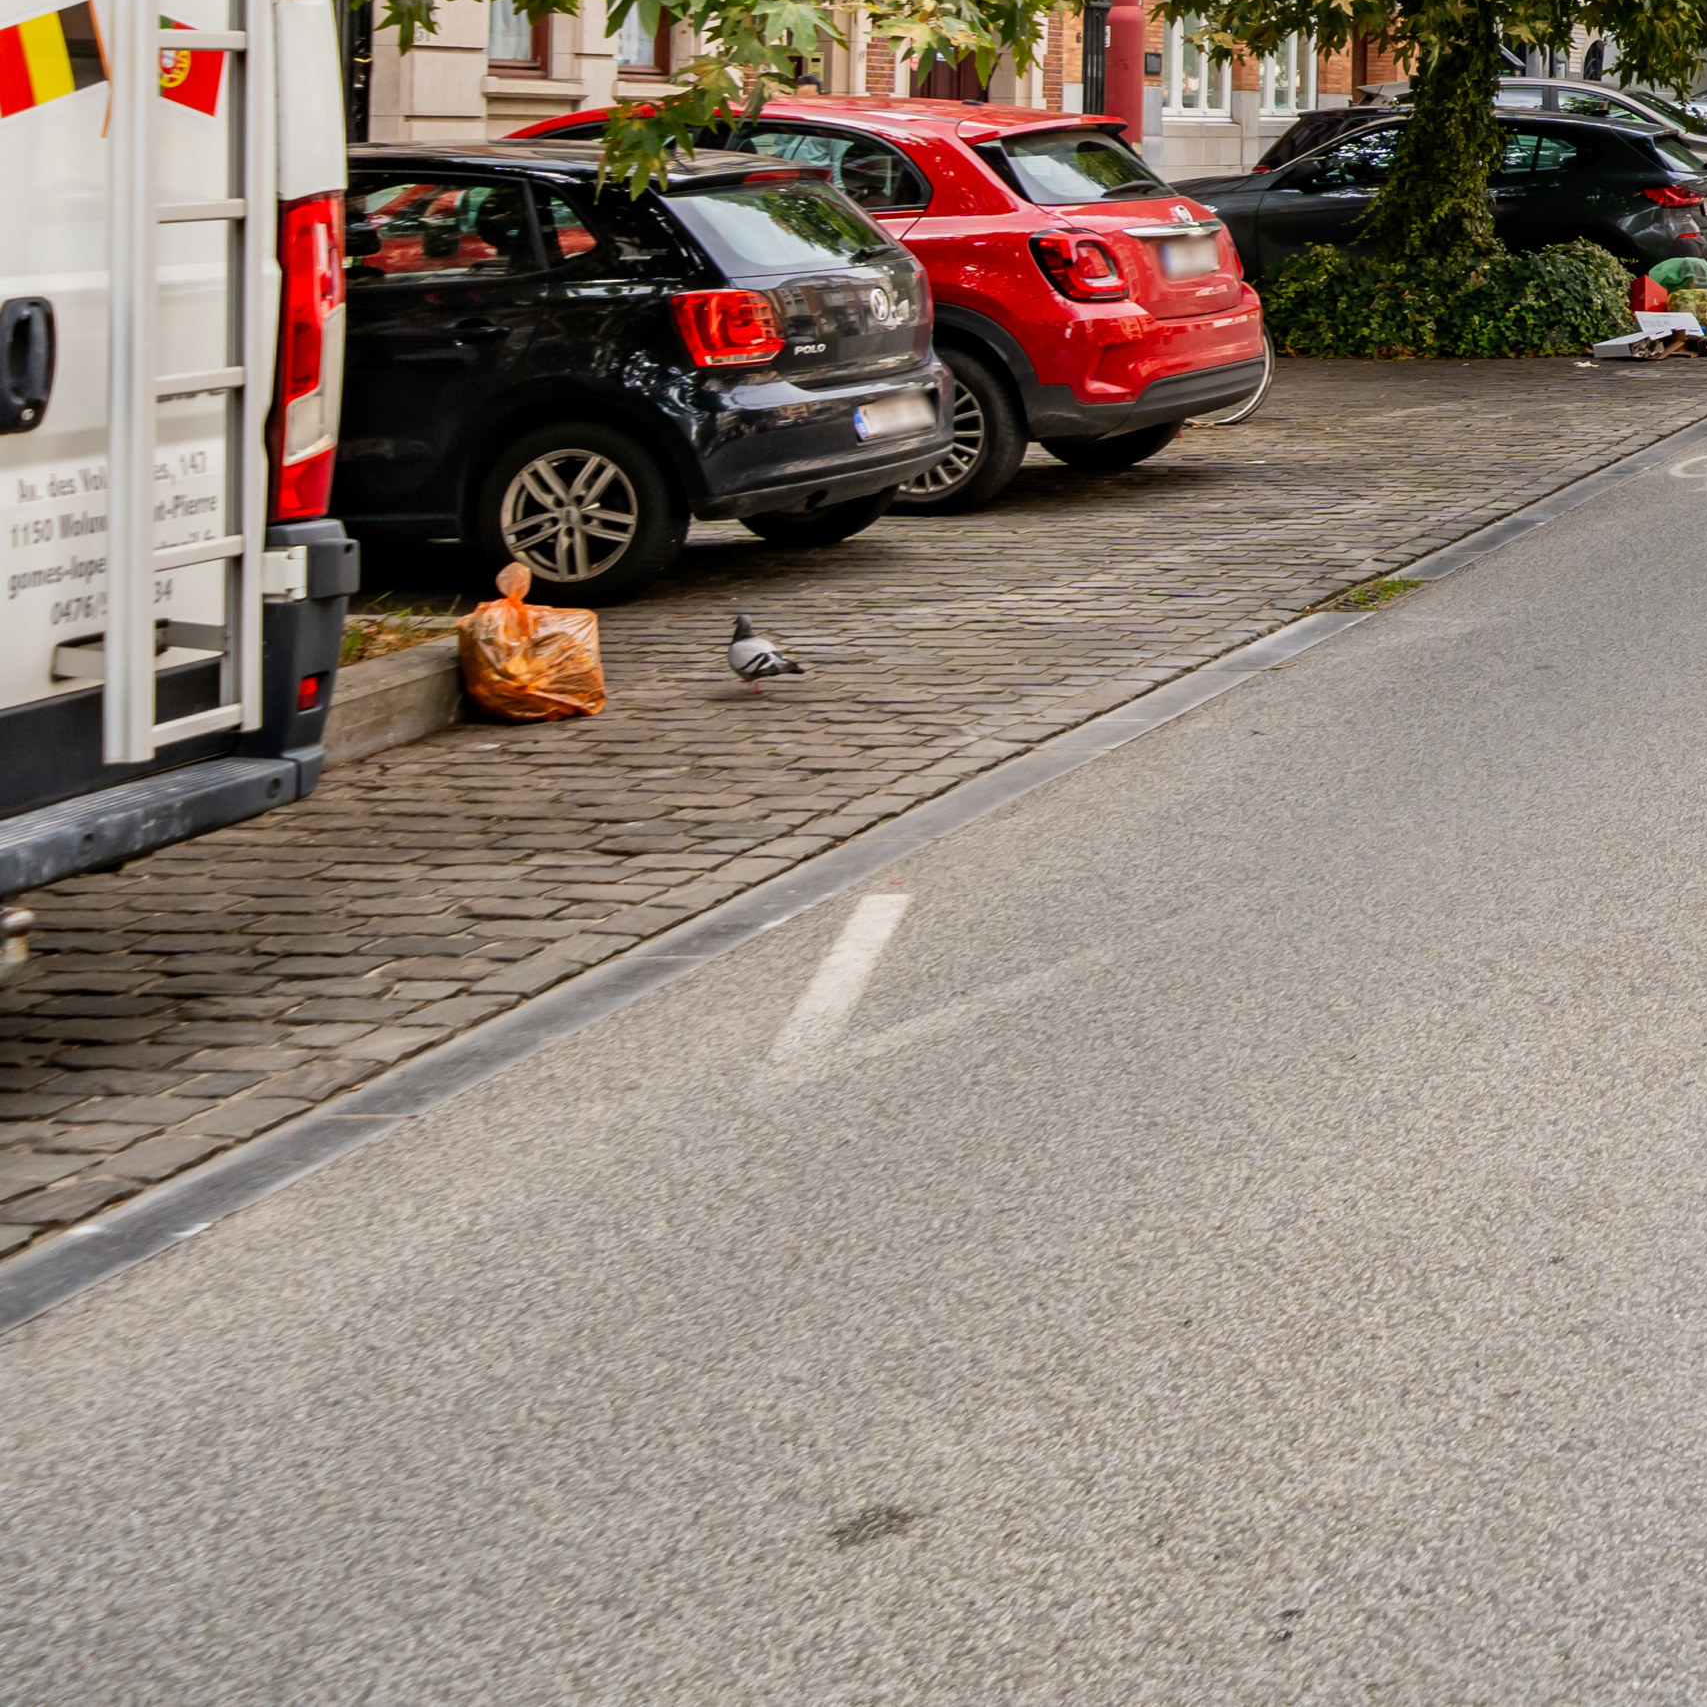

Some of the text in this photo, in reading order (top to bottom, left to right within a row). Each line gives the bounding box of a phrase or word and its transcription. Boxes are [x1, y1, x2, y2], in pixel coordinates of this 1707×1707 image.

[794, 344, 826, 355] POLO
[47, 473, 76, 497] des
[179, 451, 206, 477] 147
[10, 518, 54, 549] 1150
